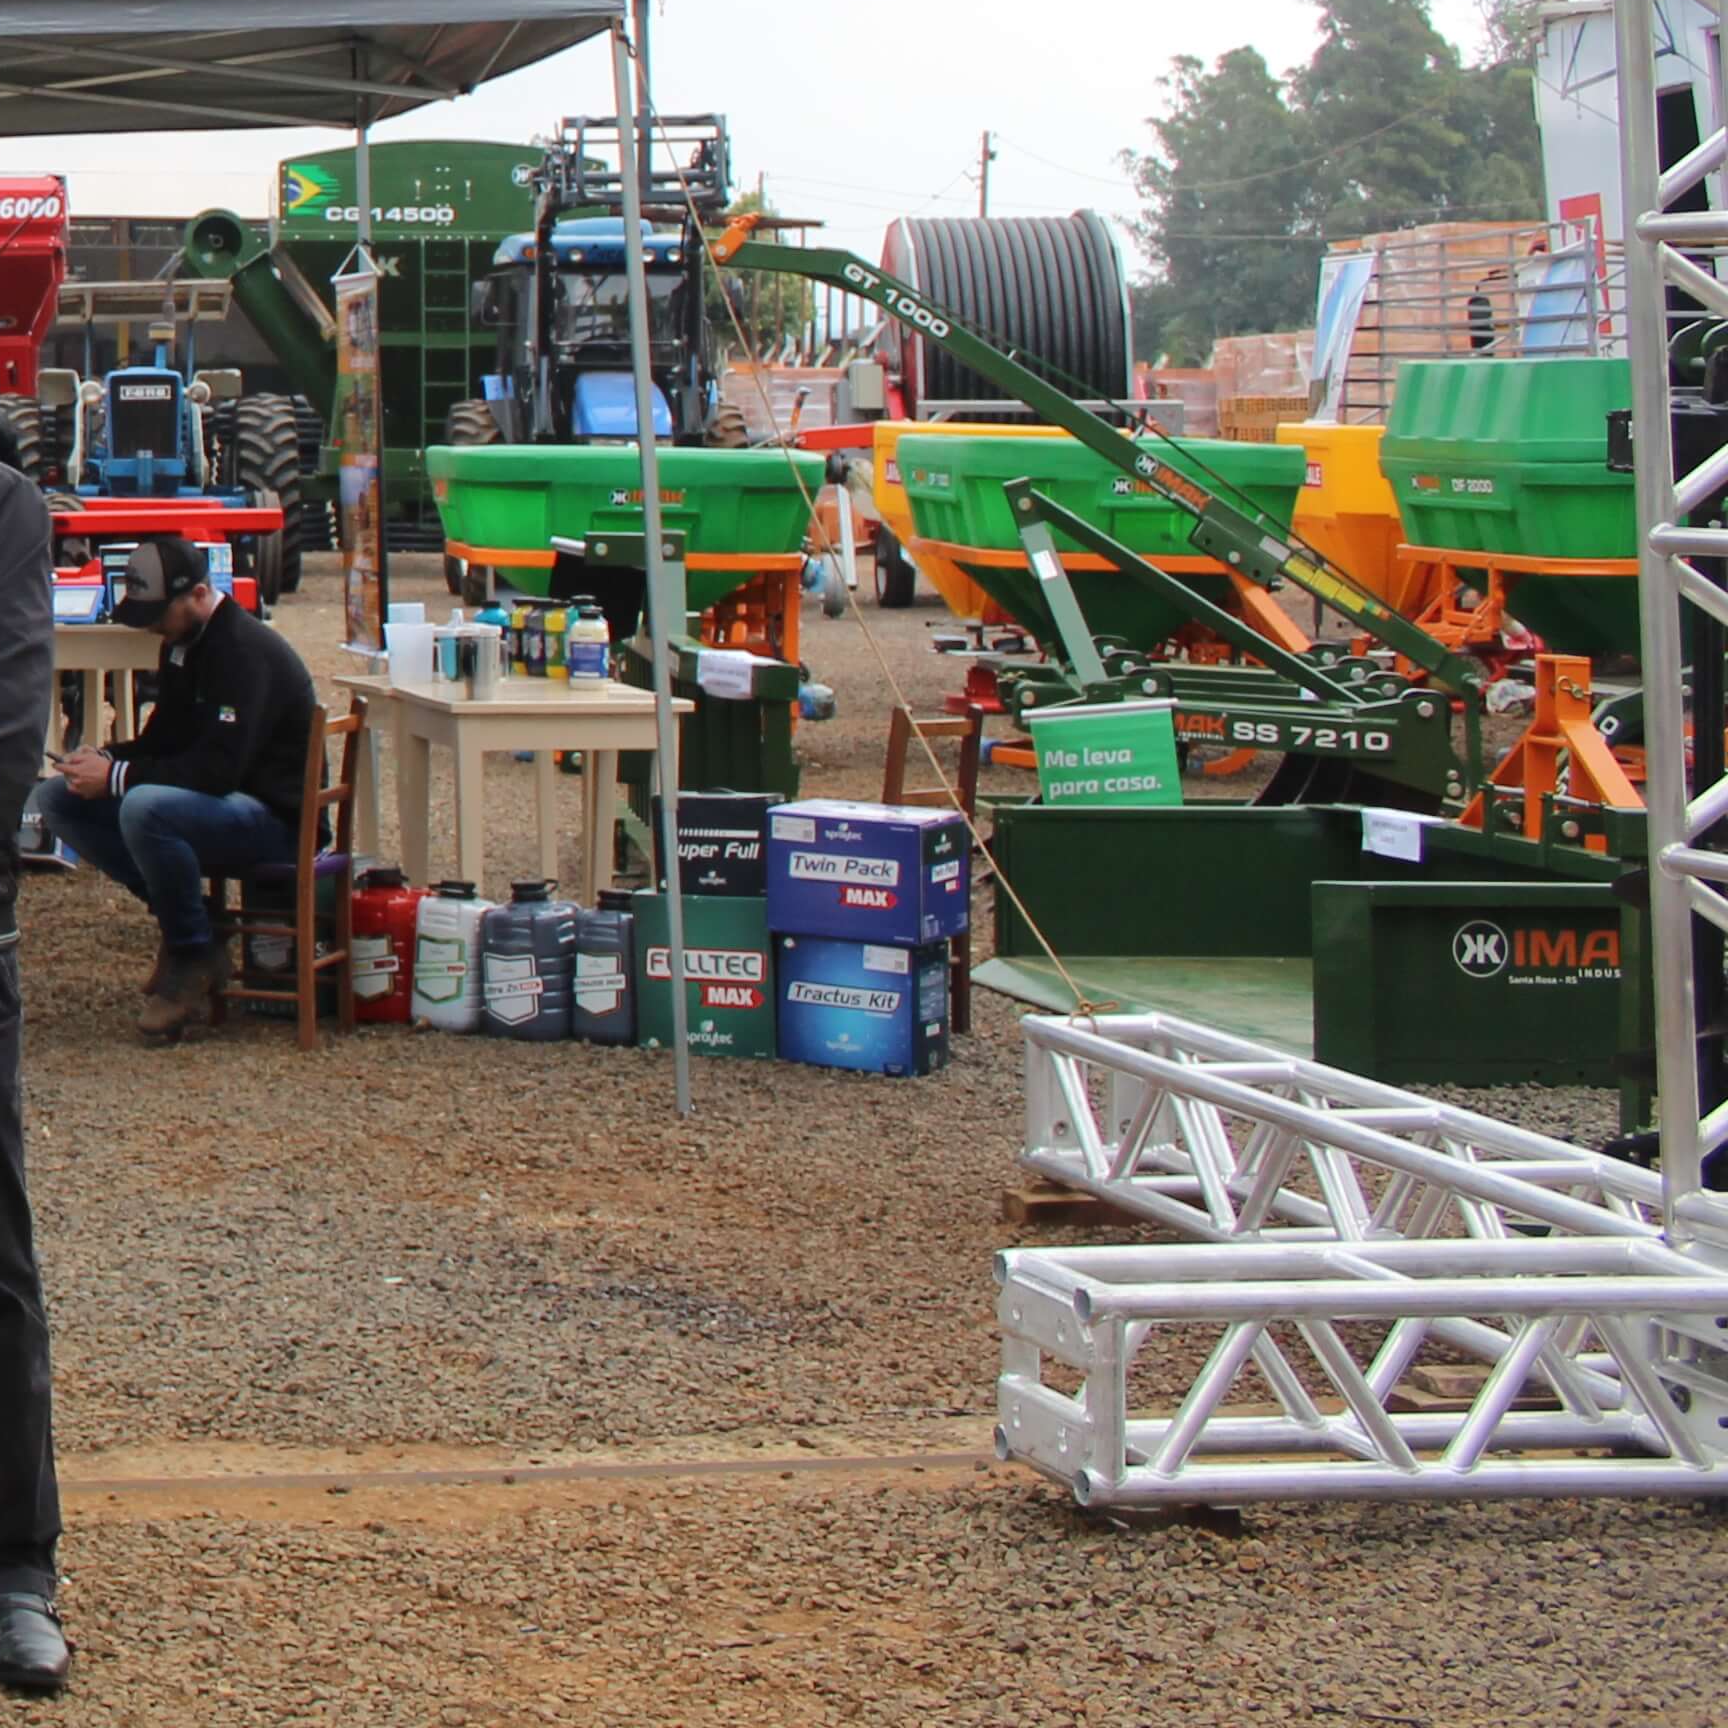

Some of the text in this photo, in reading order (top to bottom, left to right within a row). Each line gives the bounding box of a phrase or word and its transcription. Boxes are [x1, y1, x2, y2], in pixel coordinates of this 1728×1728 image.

[325, 206, 456, 222] CG 14500
[844, 263, 949, 338] GT 1000
[1232, 720, 1279, 743] SS
[1290, 725, 1390, 752] 7210
[1044, 746, 1132, 768] Me leva
[1049, 773, 1162, 799] para casa.
[678, 842, 760, 861] uper Full
[793, 856, 892, 878] Twin Pack
[845, 888, 888, 906] MAX
[1512, 929, 1620, 968] IMA
[650, 951, 759, 976] FLLTEC
[707, 986, 754, 1007] MAX
[793, 985, 896, 1010] Tractus Kit
